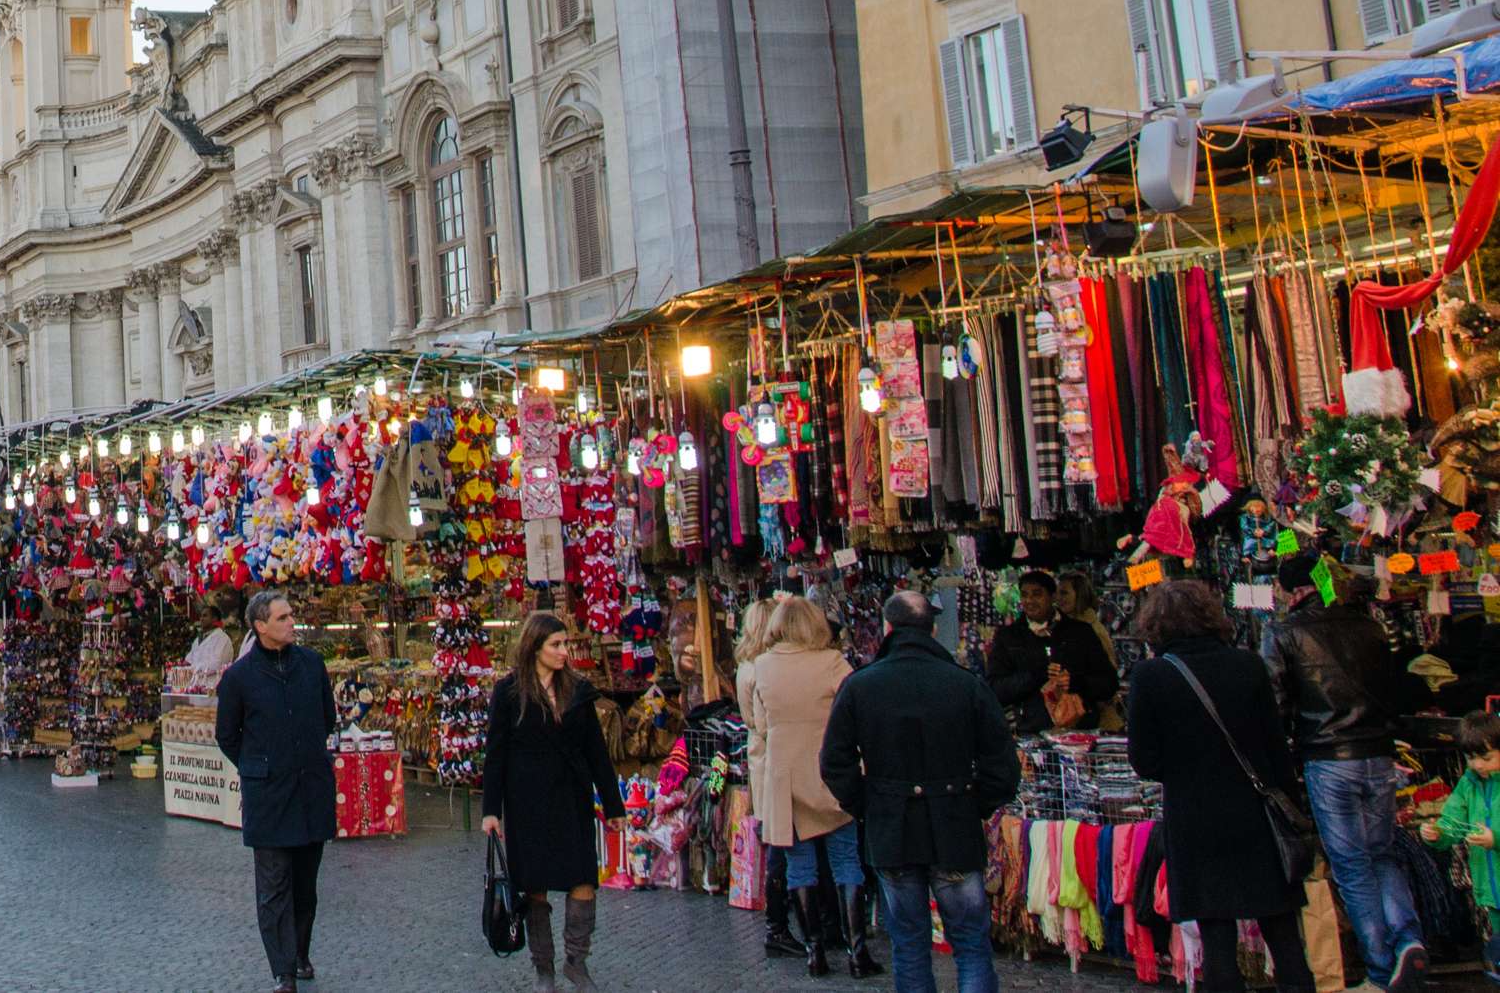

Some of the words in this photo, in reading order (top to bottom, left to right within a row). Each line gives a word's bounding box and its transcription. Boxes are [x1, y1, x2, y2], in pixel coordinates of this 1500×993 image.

[170, 755, 175, 765] IL
[177, 755, 204, 768] PROFUMO
[204, 758, 223, 771] DELLA
[164, 771, 198, 785] CIAMBELLA
[199, 775, 219, 788] CALDA
[173, 788, 194, 800] PIAZZA
